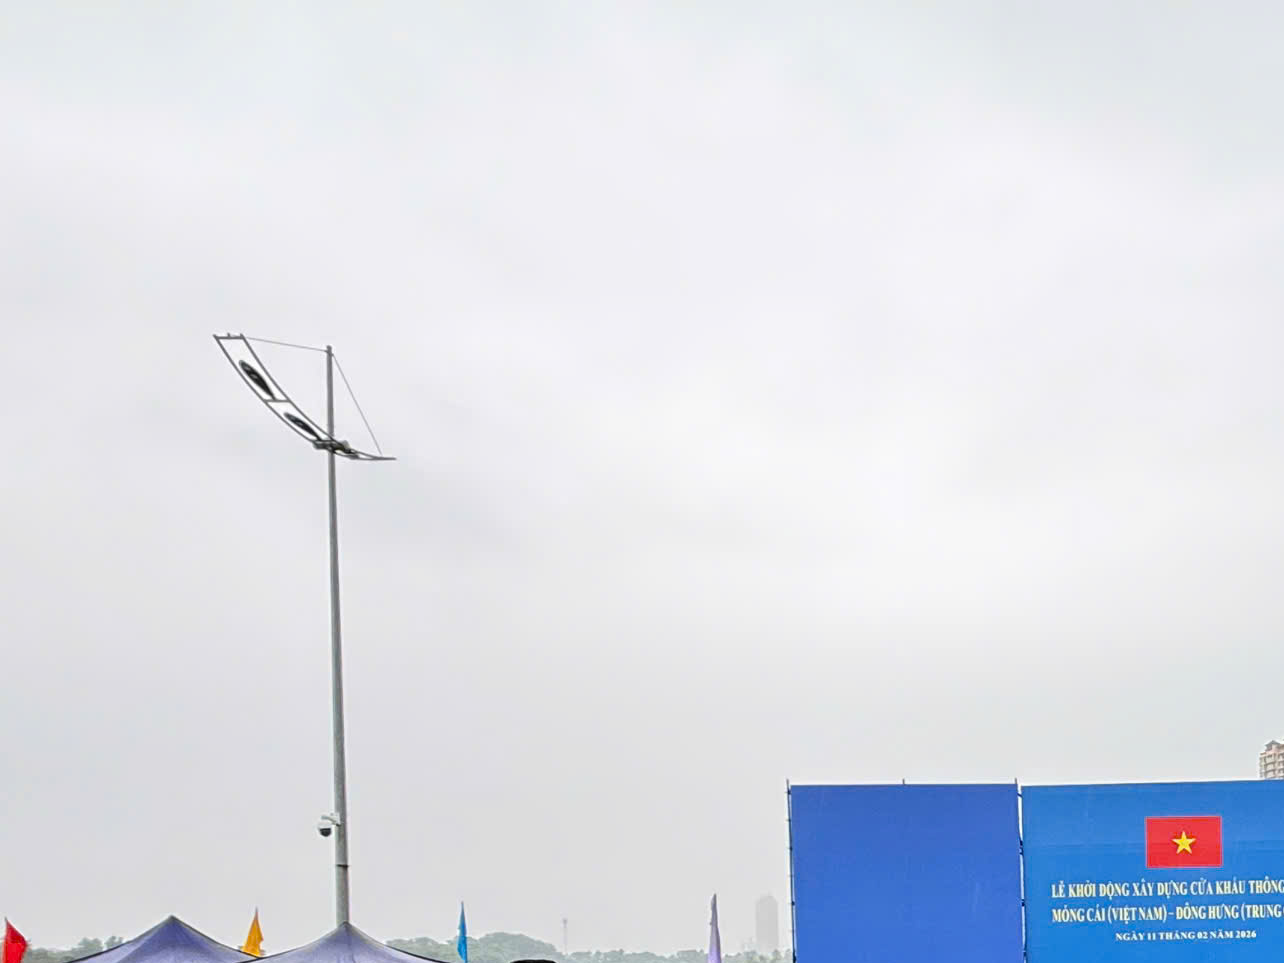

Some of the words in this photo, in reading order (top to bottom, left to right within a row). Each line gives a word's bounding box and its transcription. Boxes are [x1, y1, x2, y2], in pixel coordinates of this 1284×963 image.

[1068, 880, 1096, 898] KHỞI
[1099, 881, 1130, 900] ĐỘNG
[1132, 878, 1154, 897] XÂY
[1157, 880, 1188, 899] DỰNG
[1190, 877, 1213, 896] CỬA
[1052, 904, 1085, 922] MÓNG
[1087, 903, 1105, 922] CÁI
[1107, 904, 1137, 925] (VIỆT
[1139, 904, 1167, 923] NAM)
[1176, 902, 1206, 920] ĐÔNG
[1208, 903, 1239, 920] HƯNG
[1241, 902, 1282, 921] (TRUNG
[1115, 930, 1144, 941] NGÀY
[1147, 932, 1156, 941] 11
[1159, 930, 1195, 941] THÁNG
[1197, 931, 1208, 939] 02
[1210, 929, 1234, 939] NĂM
[1235, 930, 1257, 939] 2026
